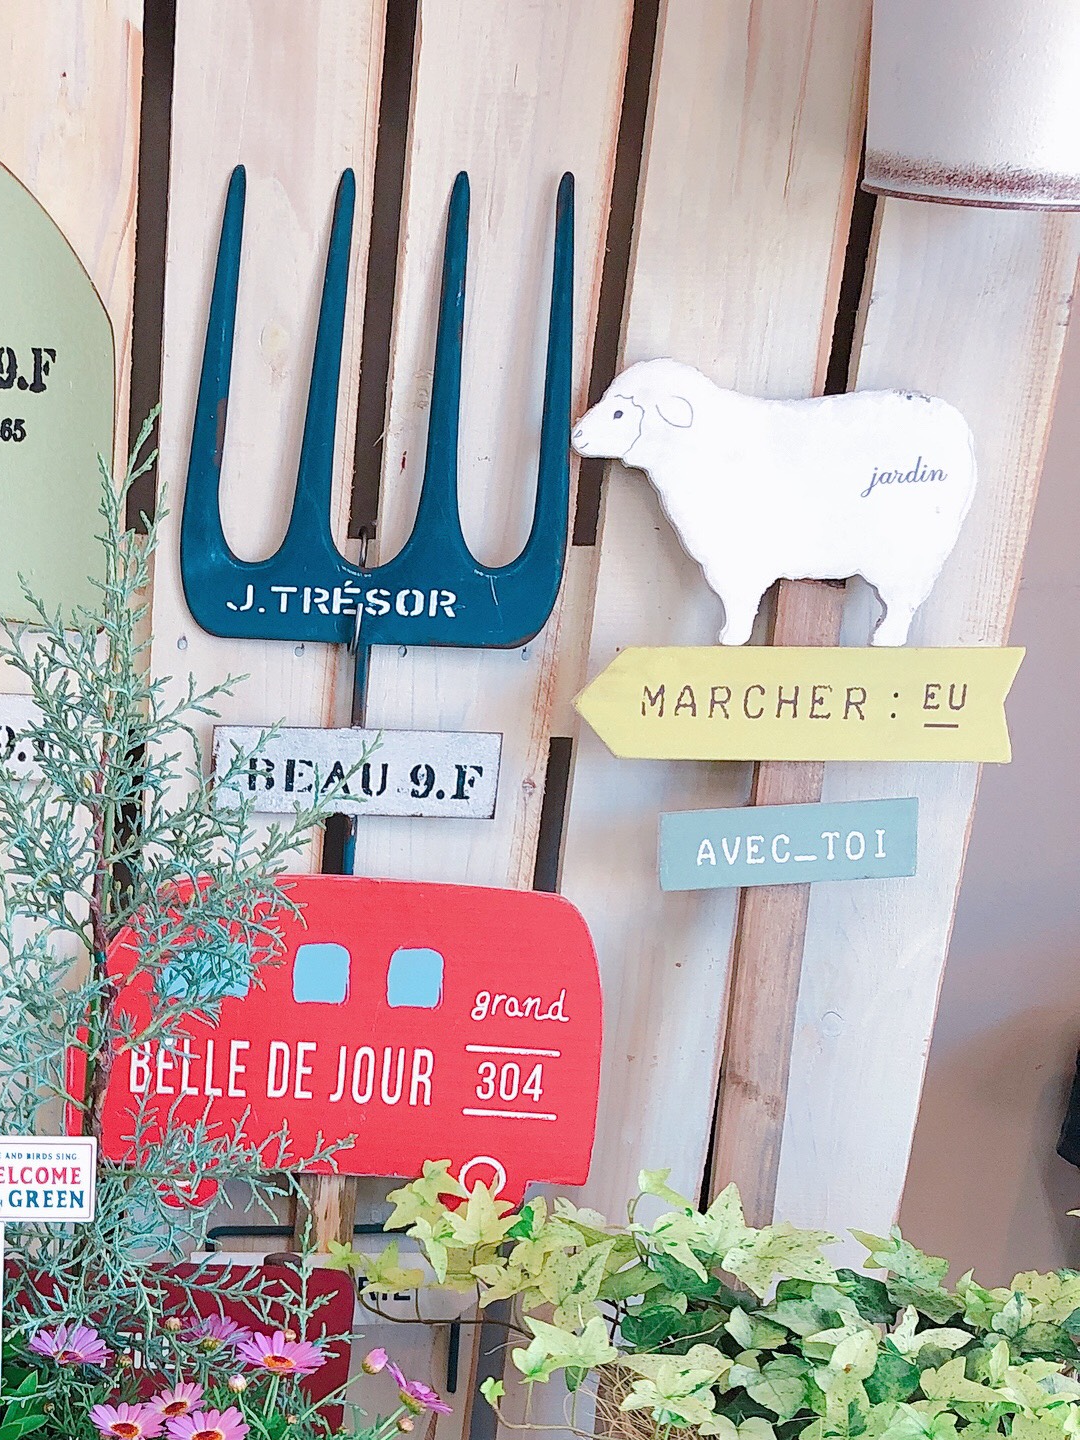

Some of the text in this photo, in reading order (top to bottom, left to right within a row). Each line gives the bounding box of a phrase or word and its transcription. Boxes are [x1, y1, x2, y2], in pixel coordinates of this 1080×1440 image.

[860, 456, 948, 498] jardin
[641, 684, 868, 720] MARCHER
[922, 683, 968, 711] EU
[248, 757, 484, 800] BEAU 9.F
[695, 829, 887, 867] AVEC_TOI
[470, 989, 570, 1023] grand
[128, 1039, 435, 1107] BELLE DE JOUR
[475, 1061, 544, 1103] 304
[5, 1151, 23, 1160] AND
[26, 1152, 53, 1160] BIRDS
[9, 1190, 84, 1208] GREEN
